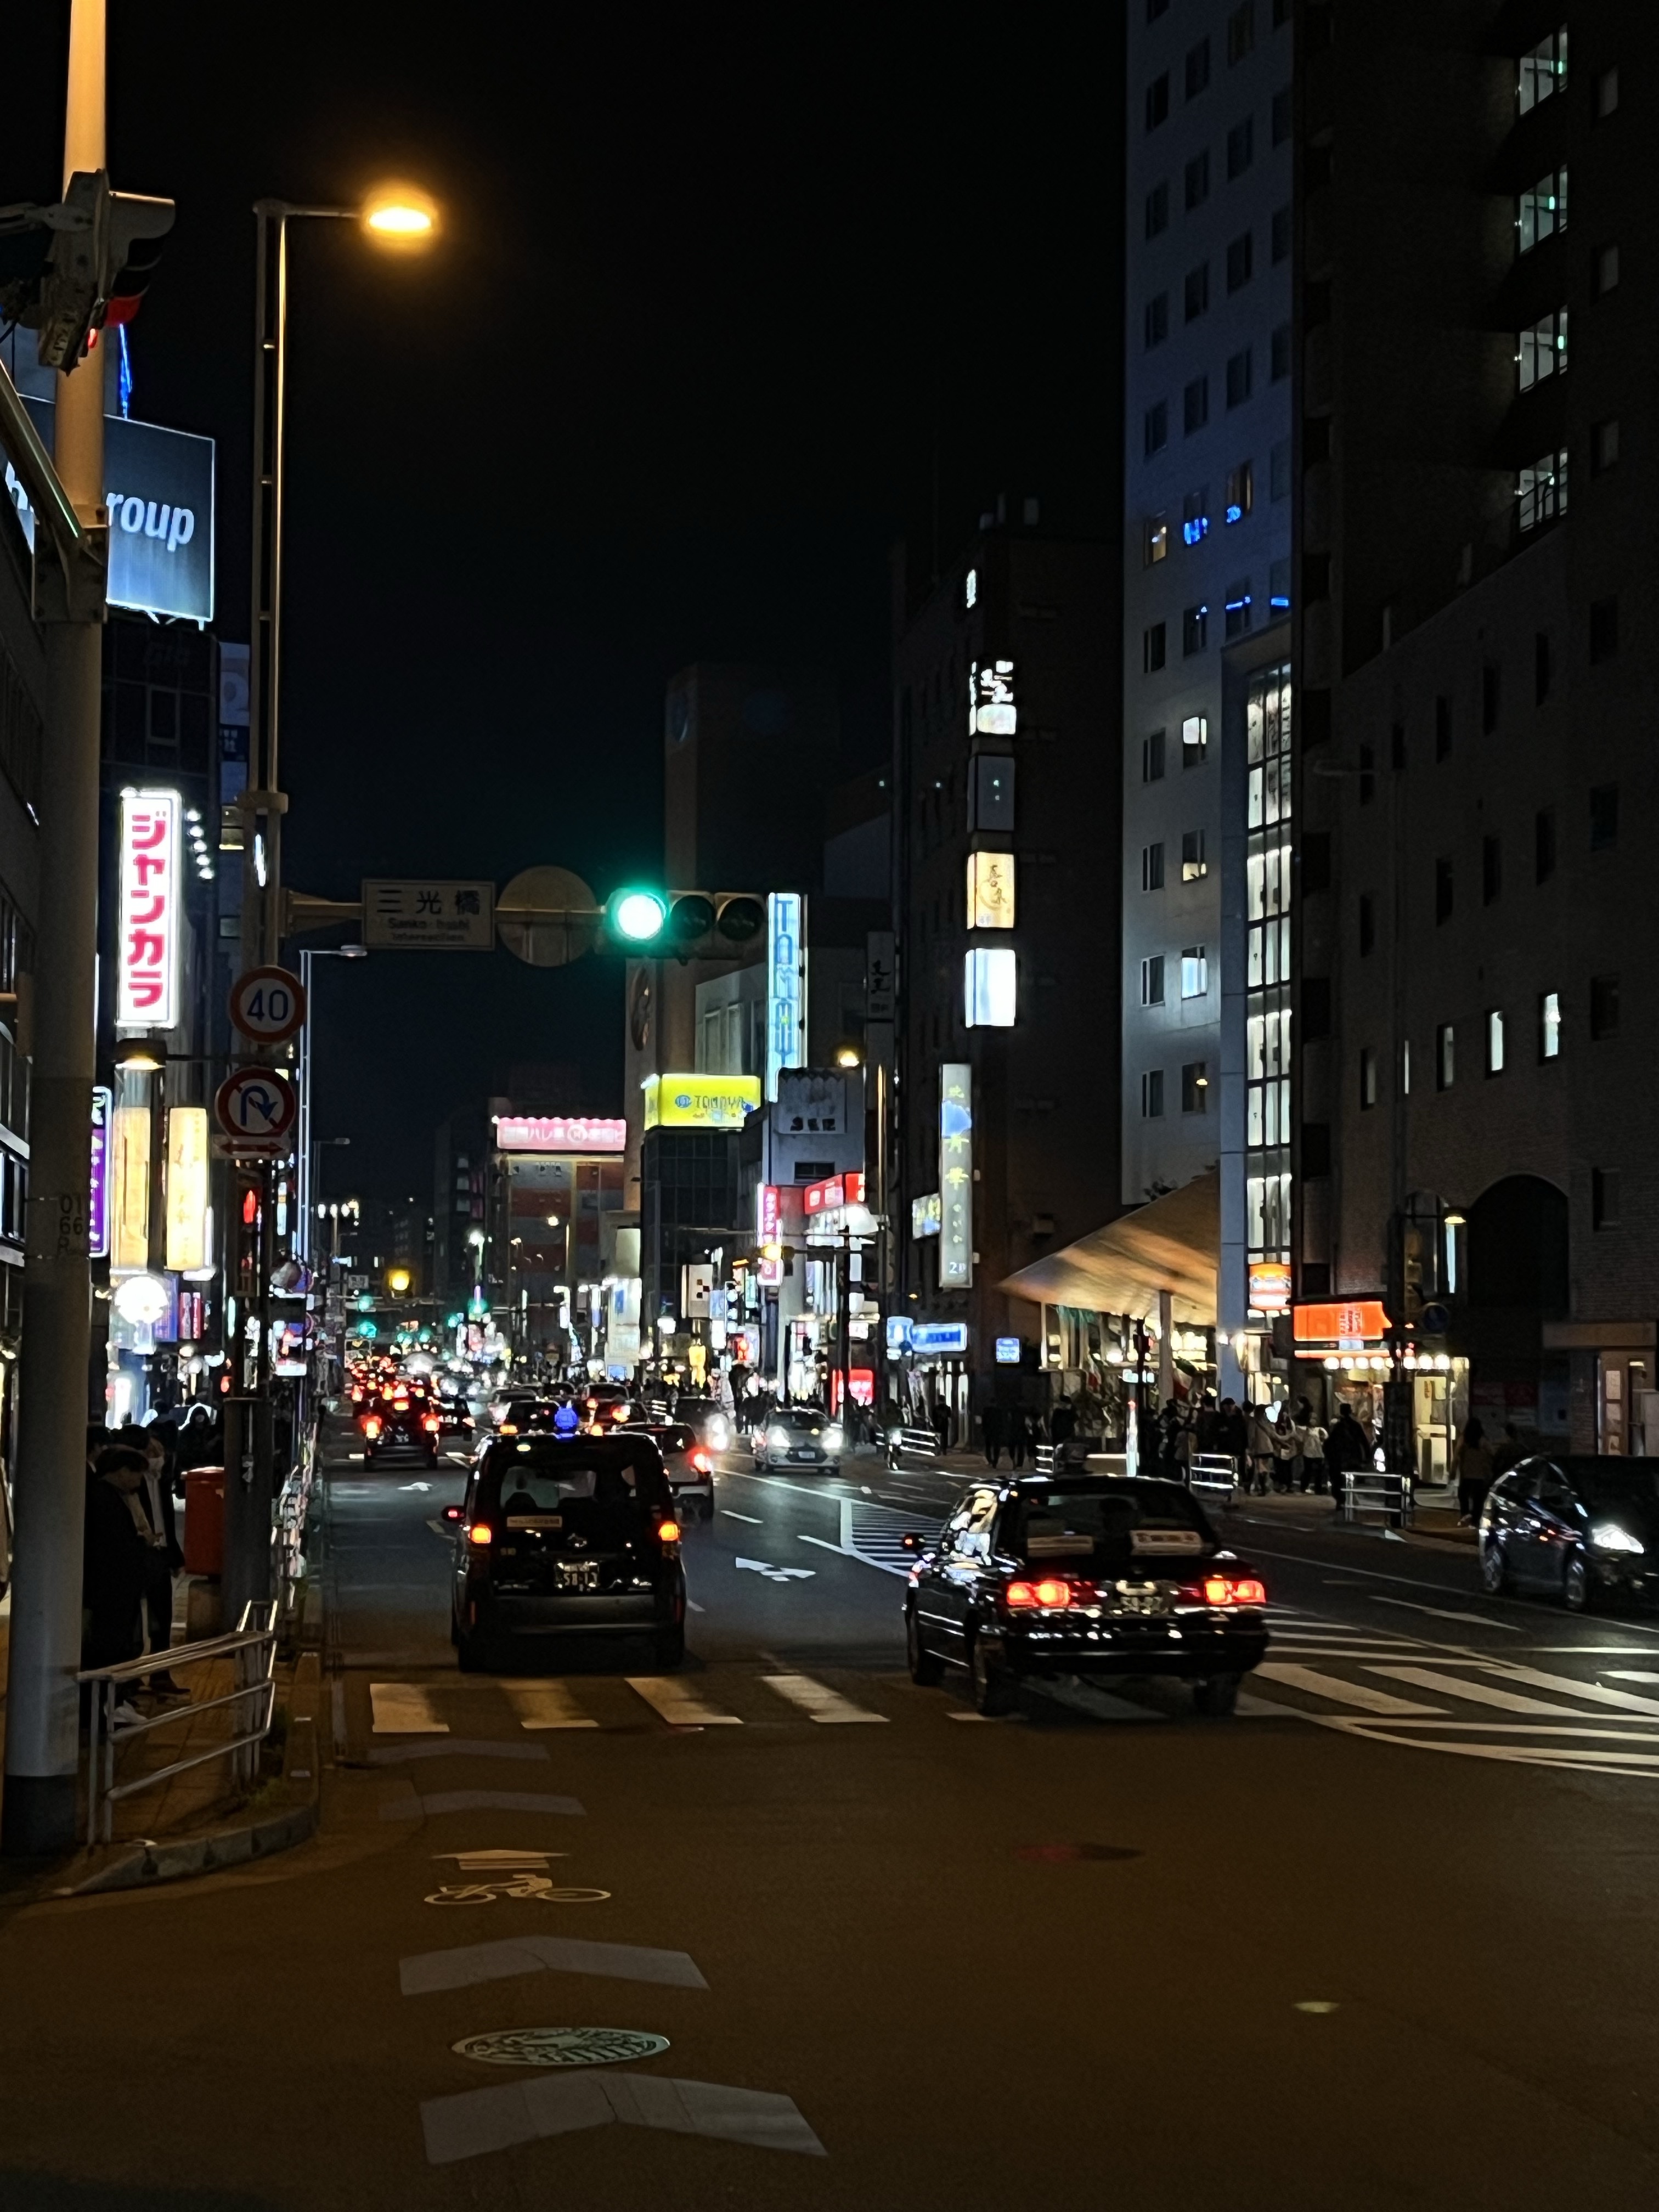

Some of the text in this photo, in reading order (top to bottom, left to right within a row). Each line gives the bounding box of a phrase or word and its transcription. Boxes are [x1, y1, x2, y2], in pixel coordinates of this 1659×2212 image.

[127, 810, 166, 1008] ジャンカラ
[377, 889, 481, 915] 三光橋
[246, 988, 290, 1022] 40
[59, 1216, 83, 1235] 66
